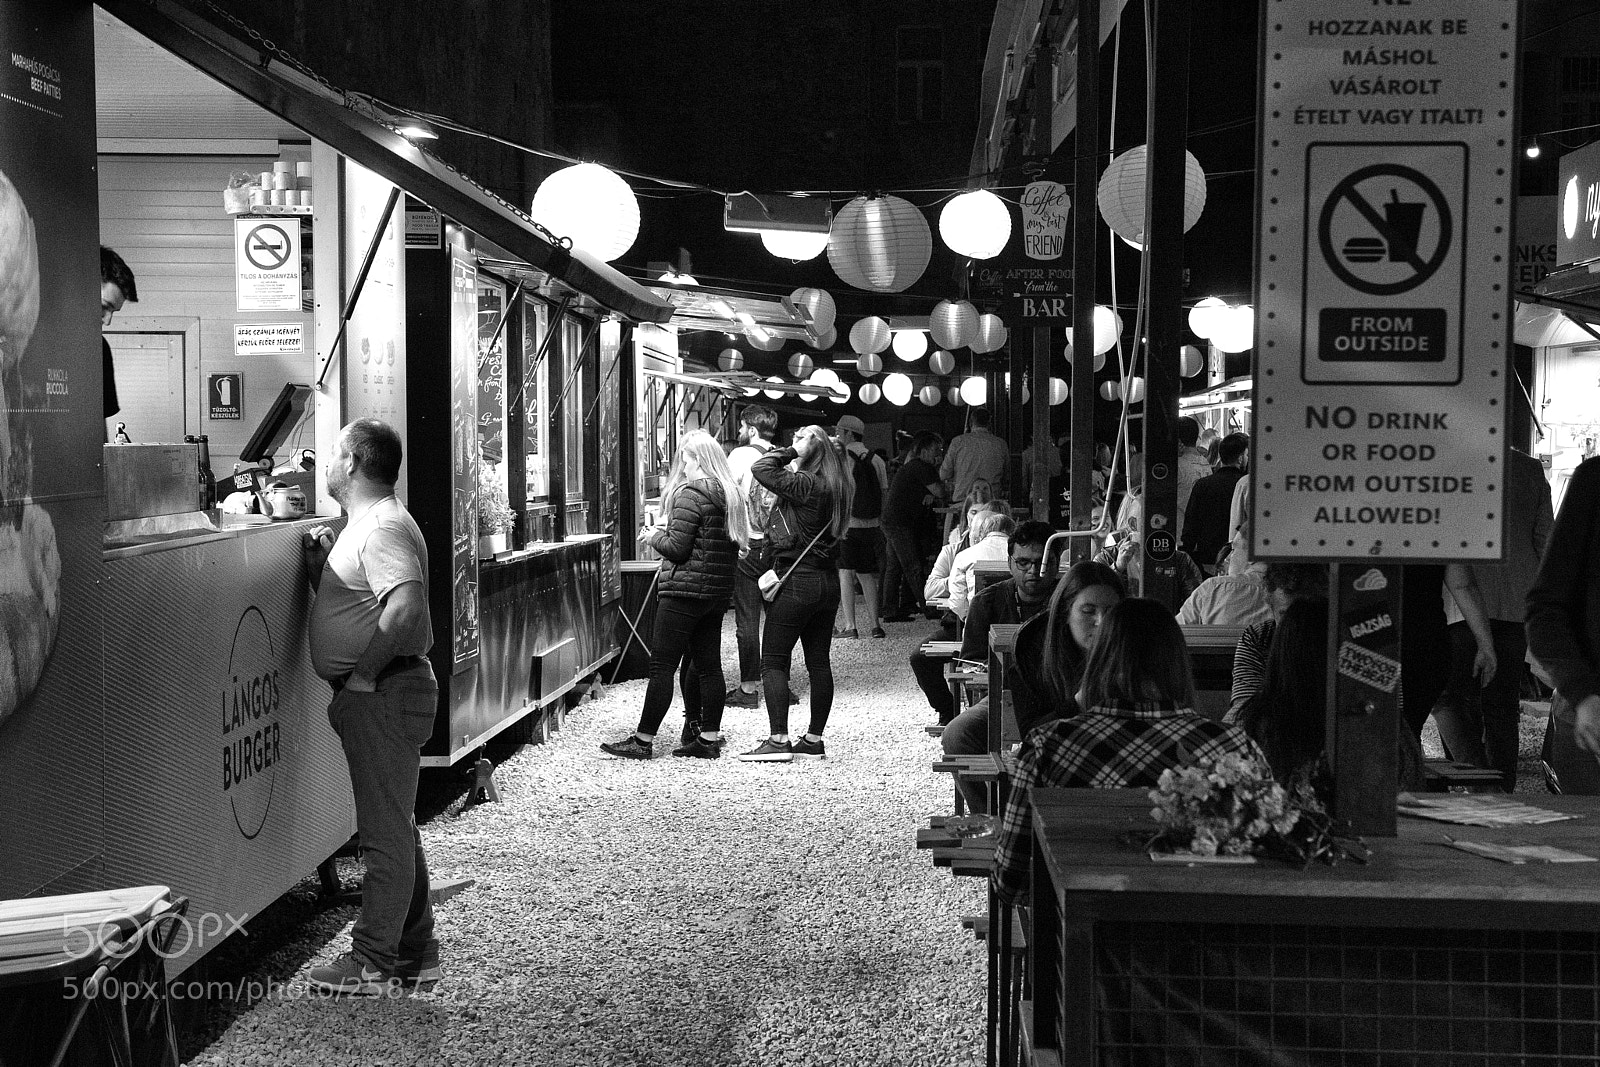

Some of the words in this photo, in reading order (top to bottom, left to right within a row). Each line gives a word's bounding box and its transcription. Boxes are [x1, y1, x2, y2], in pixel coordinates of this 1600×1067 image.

[1308, 20, 1432, 36] HOZZANAK
[1441, 19, 1467, 35] BE
[1342, 46, 1438, 66] MÁSHOL
[30, 77, 43, 93] BEEF
[1329, 75, 1442, 96] VÁSÁROLT
[1293, 105, 1351, 125] ÉTELT
[1357, 108, 1413, 125] VAGY
[1420, 107, 1483, 125] ITALT!
[1024, 185, 1065, 215] Coffee
[1025, 234, 1063, 256] FRIEND
[263, 272, 298, 280] DOHÁNYZÁS
[1006, 268, 1044, 279] AFTER
[1048, 268, 1074, 279] FOO
[1024, 280, 1045, 293] from
[1045, 281, 1059, 292] the
[1022, 298, 1069, 317] BAR
[1350, 316, 1414, 333] FROM
[1334, 335, 1430, 352] OUTSIDE
[1305, 405, 1357, 430] NO
[1367, 412, 1449, 430] DRINK
[1322, 443, 1357, 461] OR
[1367, 443, 1436, 462] FOOD
[1284, 474, 1355, 492] FROM
[1365, 475, 1474, 494] OUTSIDE
[1314, 506, 1441, 525] ALLOWED!
[1153, 538, 1170, 548] DB
[222, 669, 280, 735] LÁNGOS
[223, 722, 280, 791] BURGER
